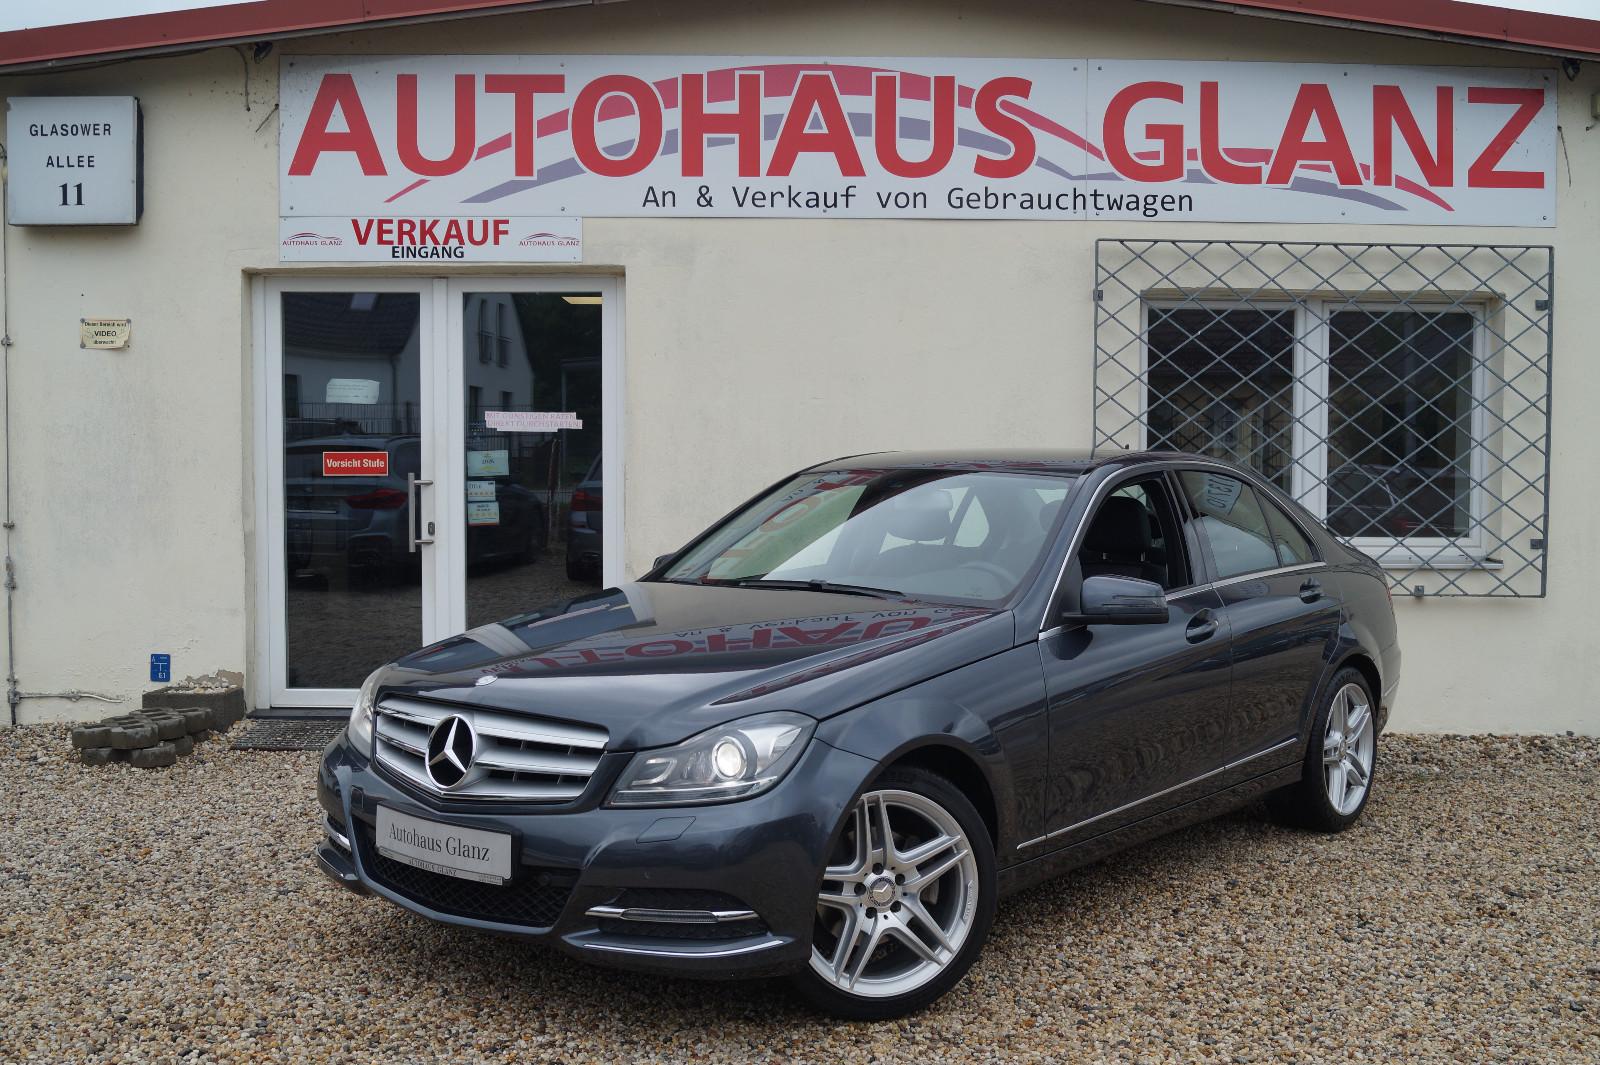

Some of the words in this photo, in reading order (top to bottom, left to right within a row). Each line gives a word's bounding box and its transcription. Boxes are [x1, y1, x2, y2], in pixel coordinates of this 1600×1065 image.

[29, 123, 112, 137] GLASOWER
[287, 72, 1037, 179] AUTOHAUS
[1101, 80, 1545, 190] GLANZ
[46, 155, 95, 168] ALLEE
[58, 182, 86, 206] 11
[641, 185, 677, 208] An
[696, 184, 714, 208] &
[732, 184, 857, 209] Verkauf
[876, 191, 928, 209] von
[947, 185, 1194, 217] Gebrauchtwagen
[351, 218, 510, 246] VERKAUF
[391, 245, 465, 259] EINGANG
[326, 458, 361, 468] Vorsicht
[362, 458, 385, 468] Stufe
[389, 821, 442, 853] Autohaus
[445, 836, 490, 862] Glanz
